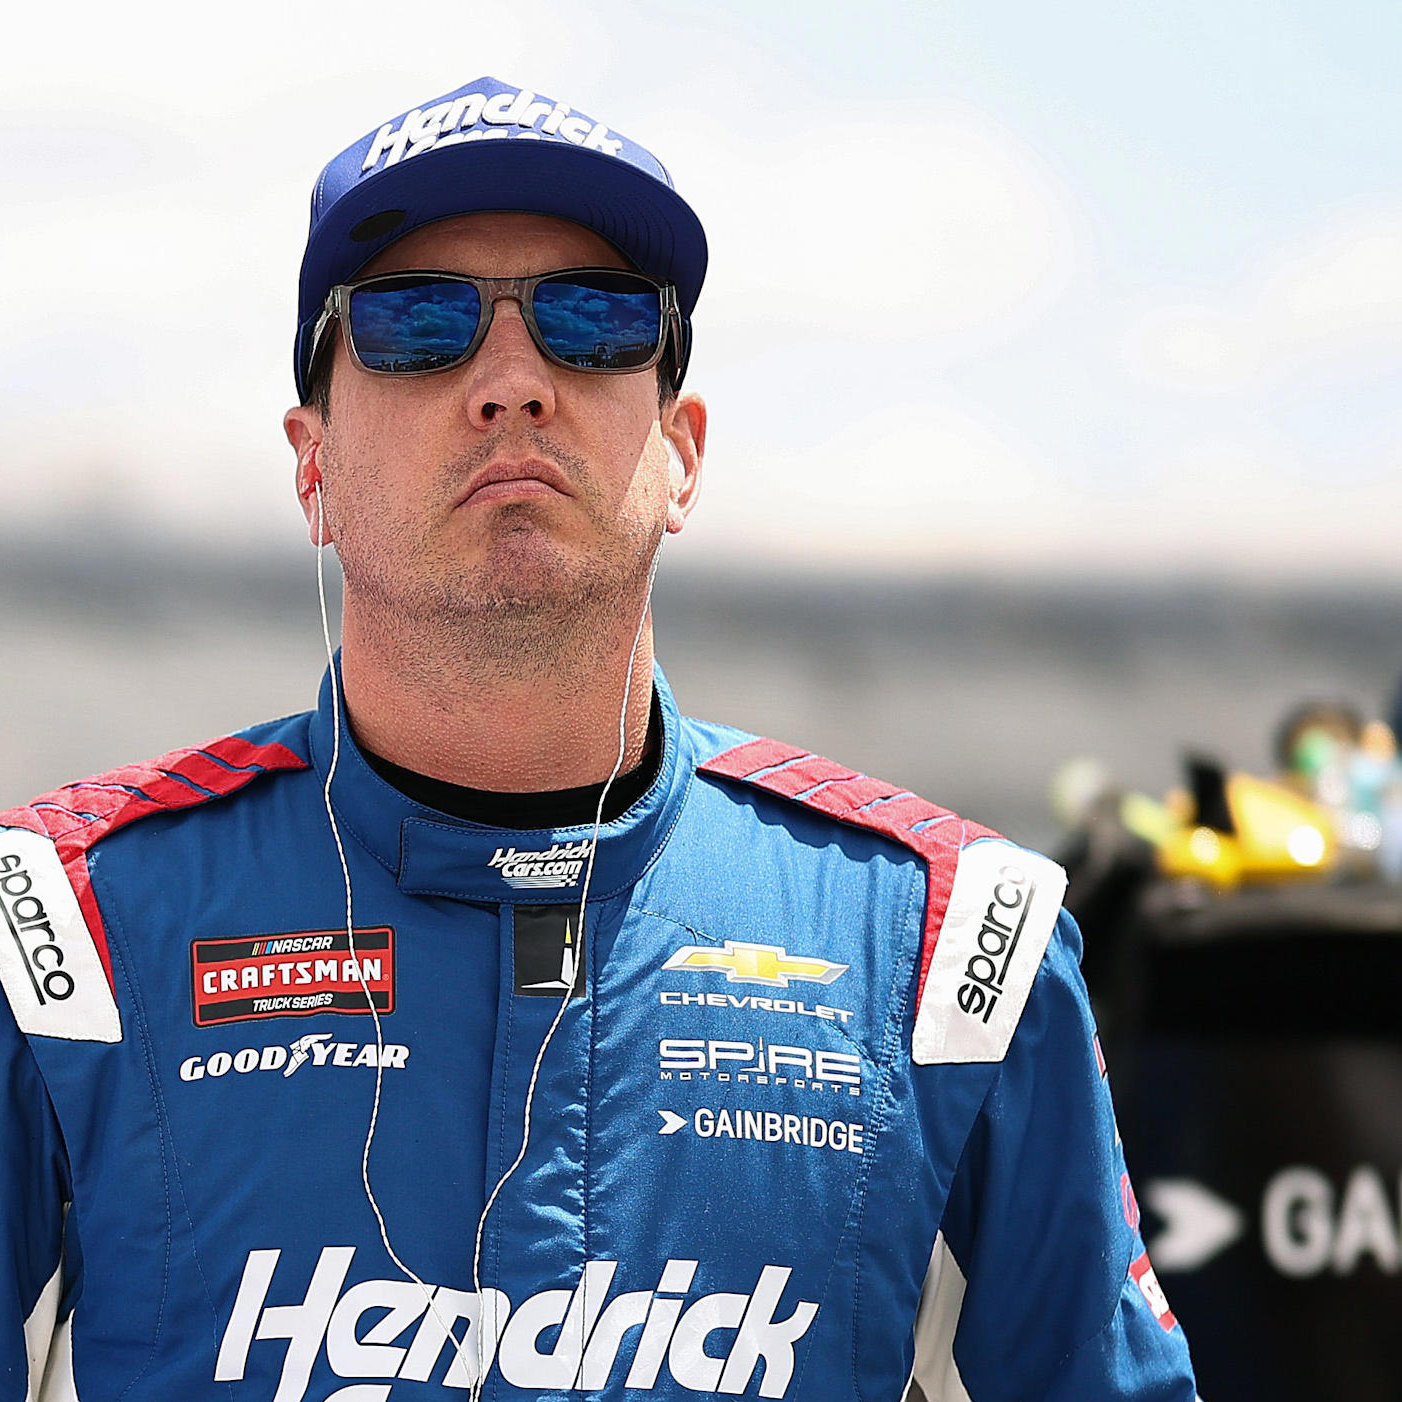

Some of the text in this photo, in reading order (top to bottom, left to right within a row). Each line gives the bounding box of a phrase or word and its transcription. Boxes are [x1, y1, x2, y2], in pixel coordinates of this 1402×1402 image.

[359, 89, 623, 172] Hendrick
[486, 838, 594, 868] Hendrick
[501, 860, 584, 878] Cars.com
[271, 936, 333, 954] NASCAR
[957, 866, 1030, 1018] sparco
[202, 958, 382, 994] CRAFTSMAN
[252, 993, 334, 1012] TRUCK SERIES
[659, 991, 855, 1023] CHEVROLET
[659, 1036, 862, 1085] SPIRE
[659, 1071, 862, 1097] MOTORSPORTS
[694, 1107, 865, 1154] GAINBRIDGE
[1260, 1164, 1402, 1278] GA
